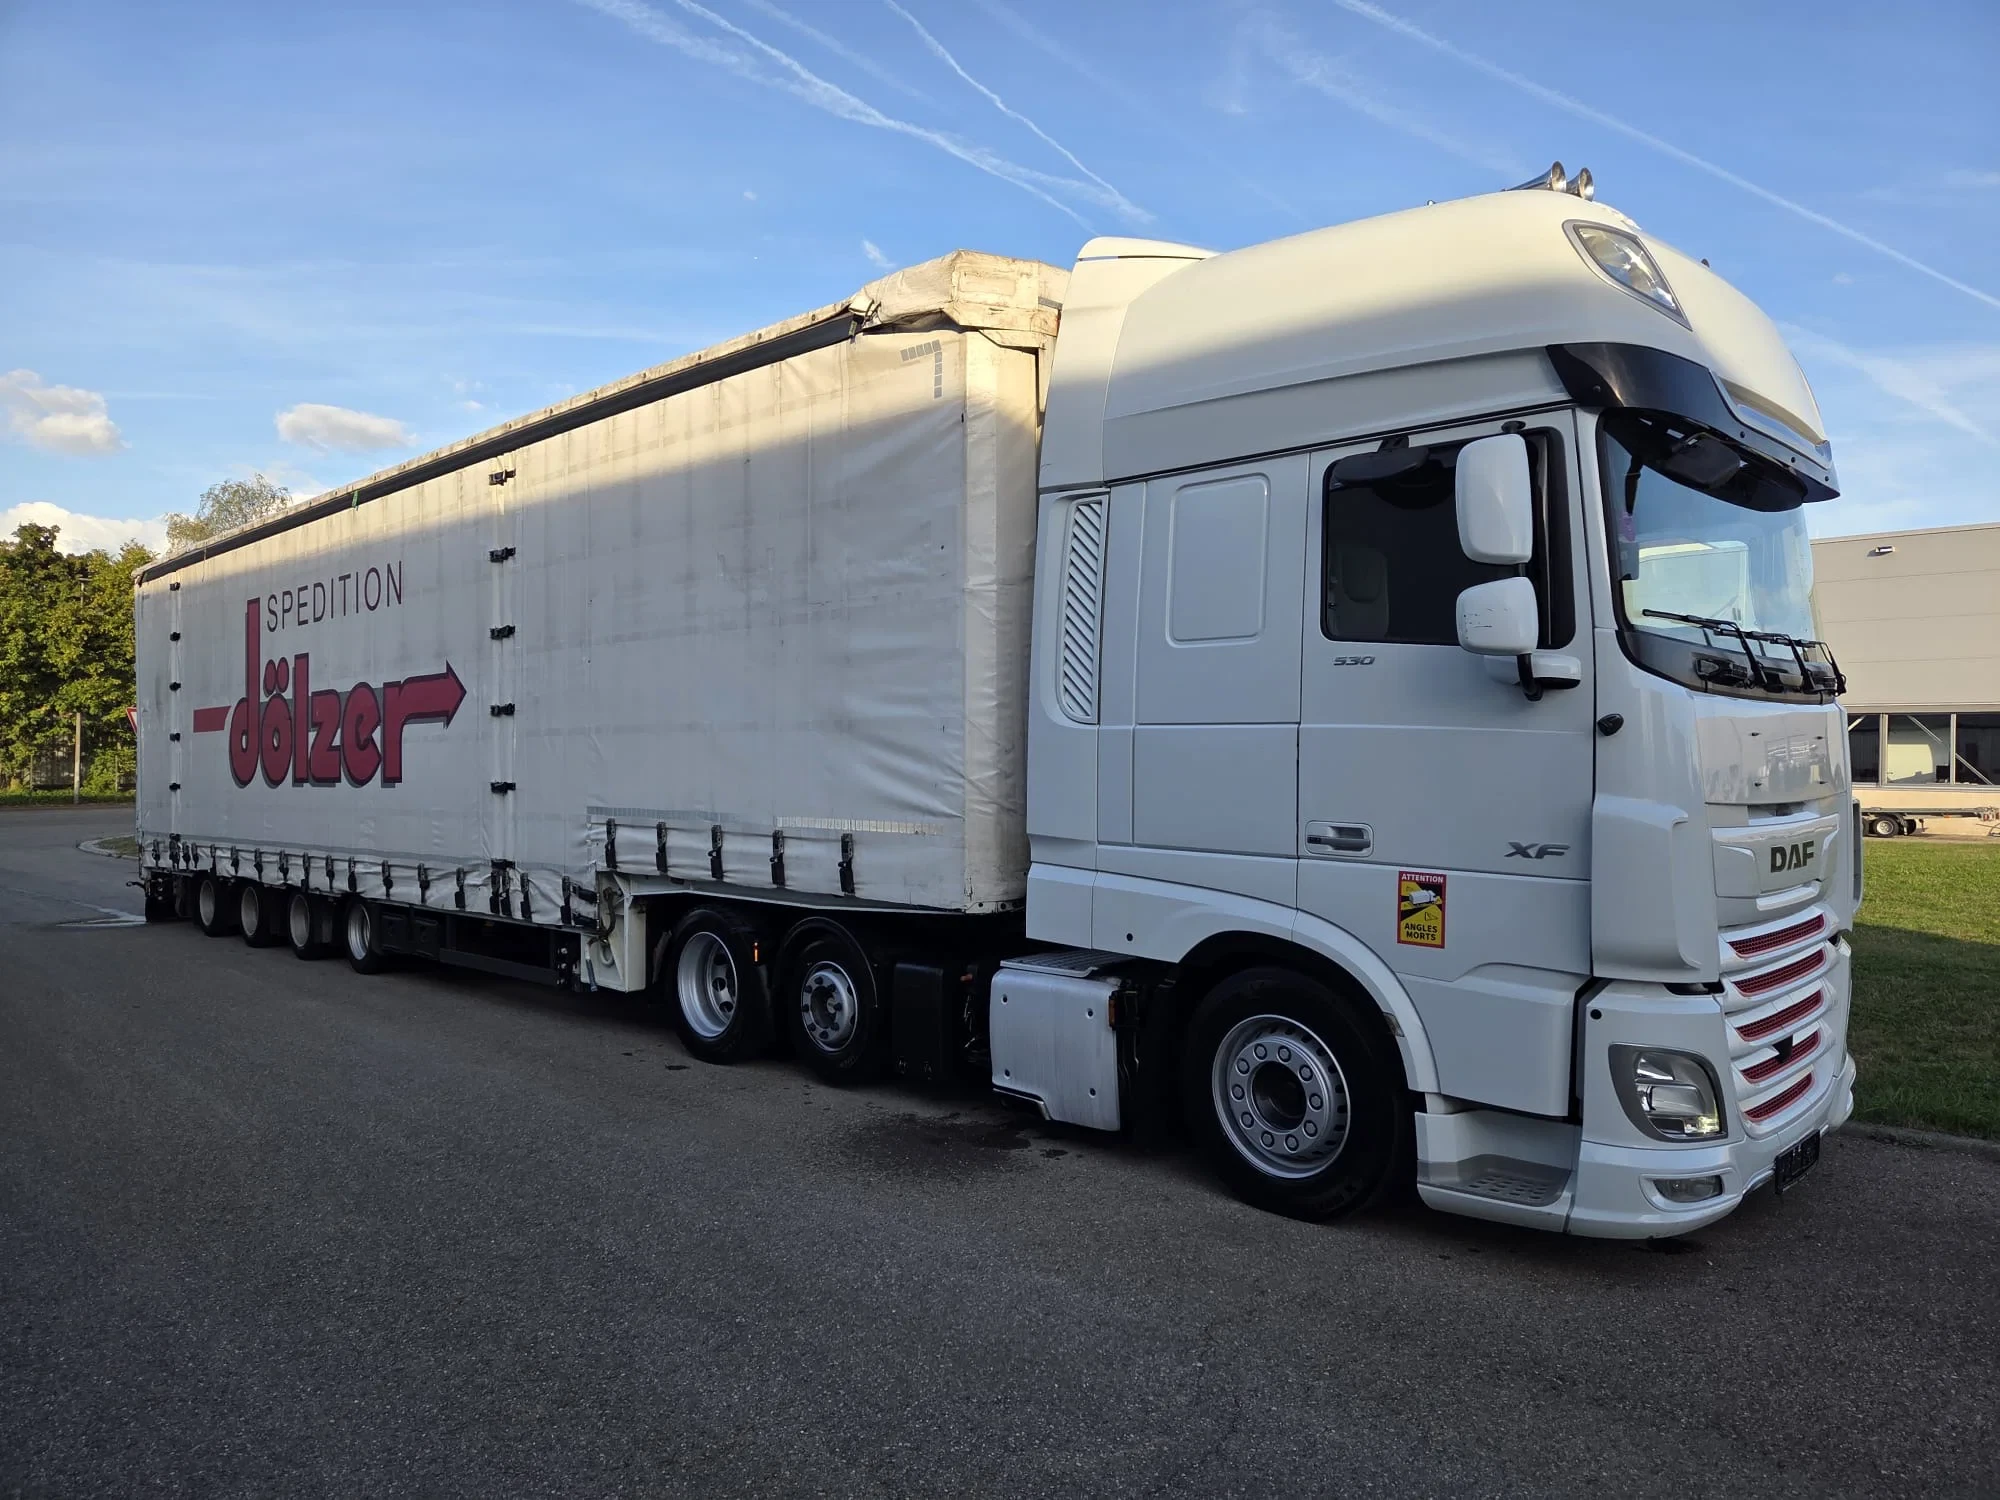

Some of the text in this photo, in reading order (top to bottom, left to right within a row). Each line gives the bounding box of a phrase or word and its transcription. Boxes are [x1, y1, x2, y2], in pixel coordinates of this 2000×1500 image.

[266, 560, 402, 632] SPEDITION
[1333, 655, 1376, 666] 530
[229, 597, 467, 788] dölzer
[1503, 841, 1571, 859] XF
[1770, 840, 1815, 873] DAF
[1401, 873, 1444, 883] ATTENTION
[1404, 923, 1438, 933] ANGLES
[1406, 931, 1437, 941] MORTS
